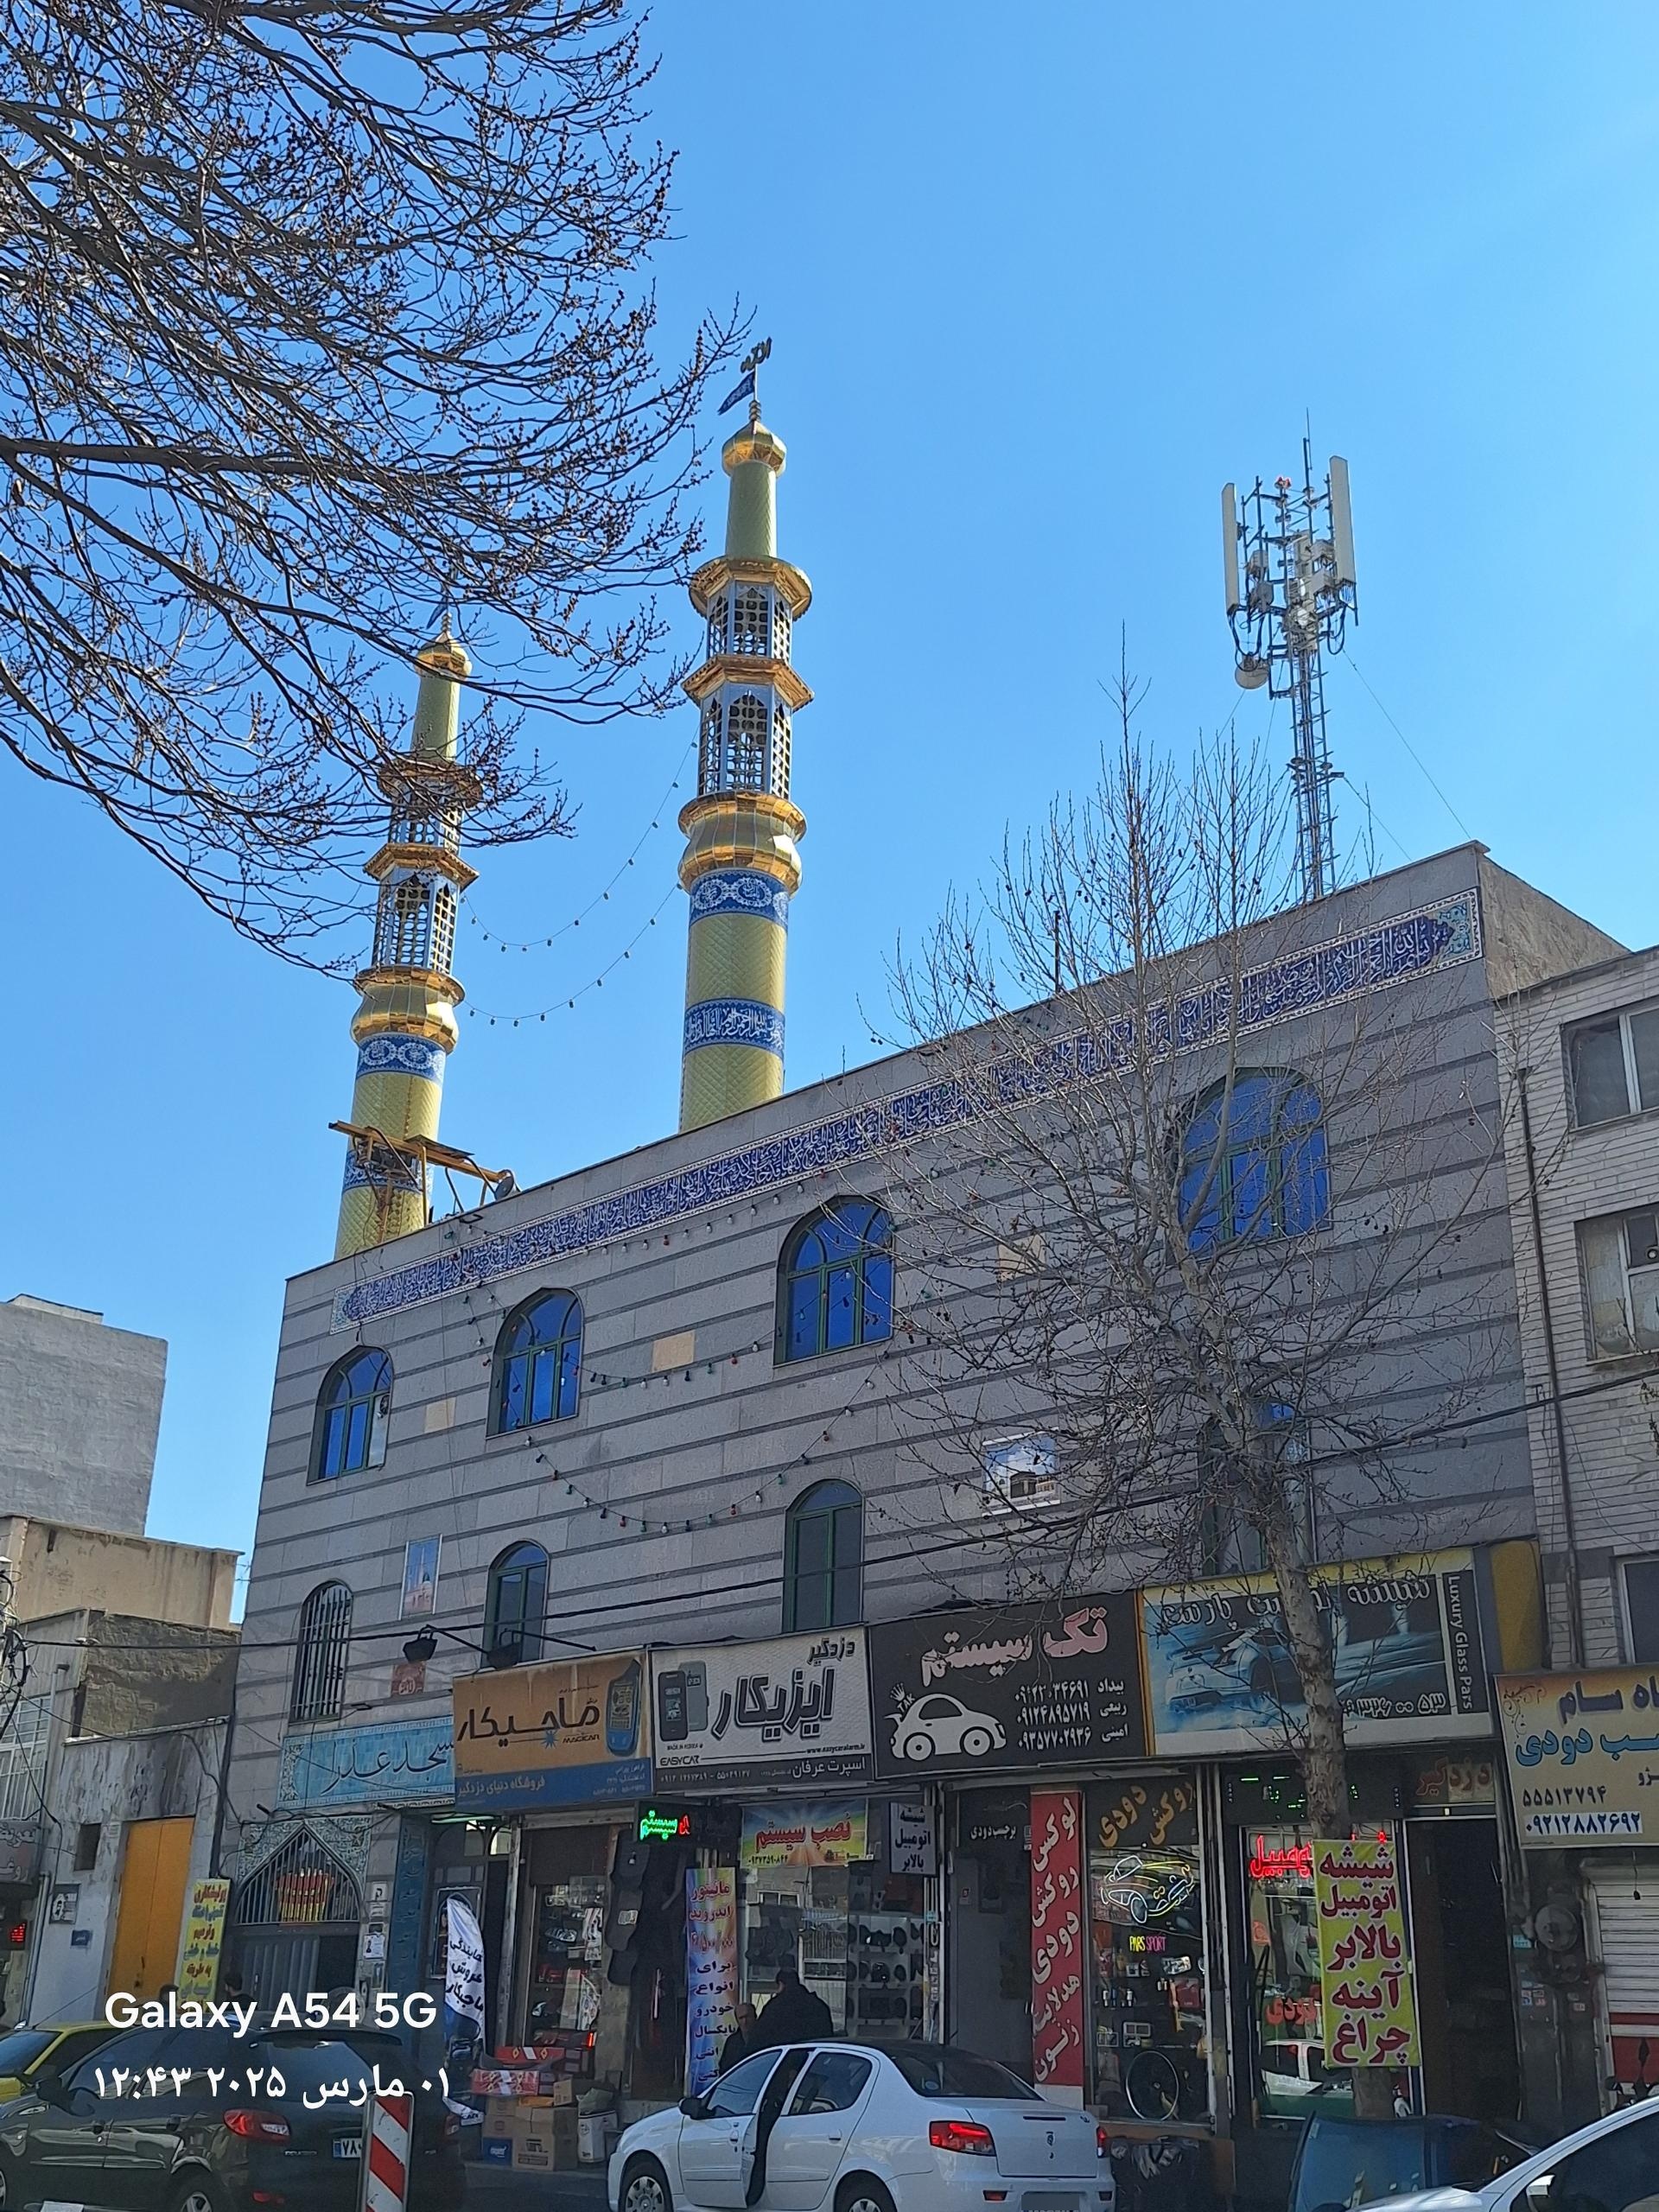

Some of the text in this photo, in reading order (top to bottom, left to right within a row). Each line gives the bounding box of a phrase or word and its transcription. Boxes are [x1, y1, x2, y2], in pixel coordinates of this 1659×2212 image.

[1346, 1570, 1431, 1611] شیشه
[807, 1637, 855, 1665] دزدگیر
[921, 1607, 1108, 1687] تک سیستم
[1447, 1575, 1472, 1710] Luxury Glass Pars
[711, 1667, 836, 1742] ایزیکار
[896, 1693, 915, 1713] TAK
[1099, 1703, 1127, 1718] ربیعی
[1559, 1681, 1624, 1725] سام
[457, 1697, 601, 1748] ماجیکار
[1101, 1723, 1128, 1743] امینی
[393, 1739, 454, 1783] سجد
[660, 1755, 700, 1767] EASYCAR
[1516, 1728, 1593, 1767] دودی
[791, 1760, 825, 1778] عرفان
[827, 1757, 865, 1777] اسپرت
[457, 1775, 545, 1797] فروشگاه دنیای دزدگیر
[1522, 1785, 1607, 1807] ۵۵۵۱۳۷۹۴
[755, 1810, 853, 1854] نصب سیستم
[1033, 1796, 1077, 1872] لوکس
[1098, 1785, 1147, 1848] دودی
[1526, 1812, 1640, 1834] ۰۹۲۱۲۸۸۲۶۹۲
[894, 1828, 931, 1853] اتومبیل
[901, 1856, 925, 1872] بالابر
[1319, 1846, 1395, 1889] شیشه
[1033, 1866, 1079, 1928] روکش
[1320, 1884, 1397, 1919] اتومبیل
[1033, 1910, 1080, 1985] دودی
[1128, 1936, 1166, 1953] PARS SPORT
[1326, 1923, 1402, 1971] بالابر
[696, 1961, 731, 1974] برای
[695, 1980, 734, 1995] انواع
[1332, 1970, 1405, 2020] آینه
[696, 2001, 734, 2018] خودرو
[1332, 2012, 1411, 2065] چراغ
